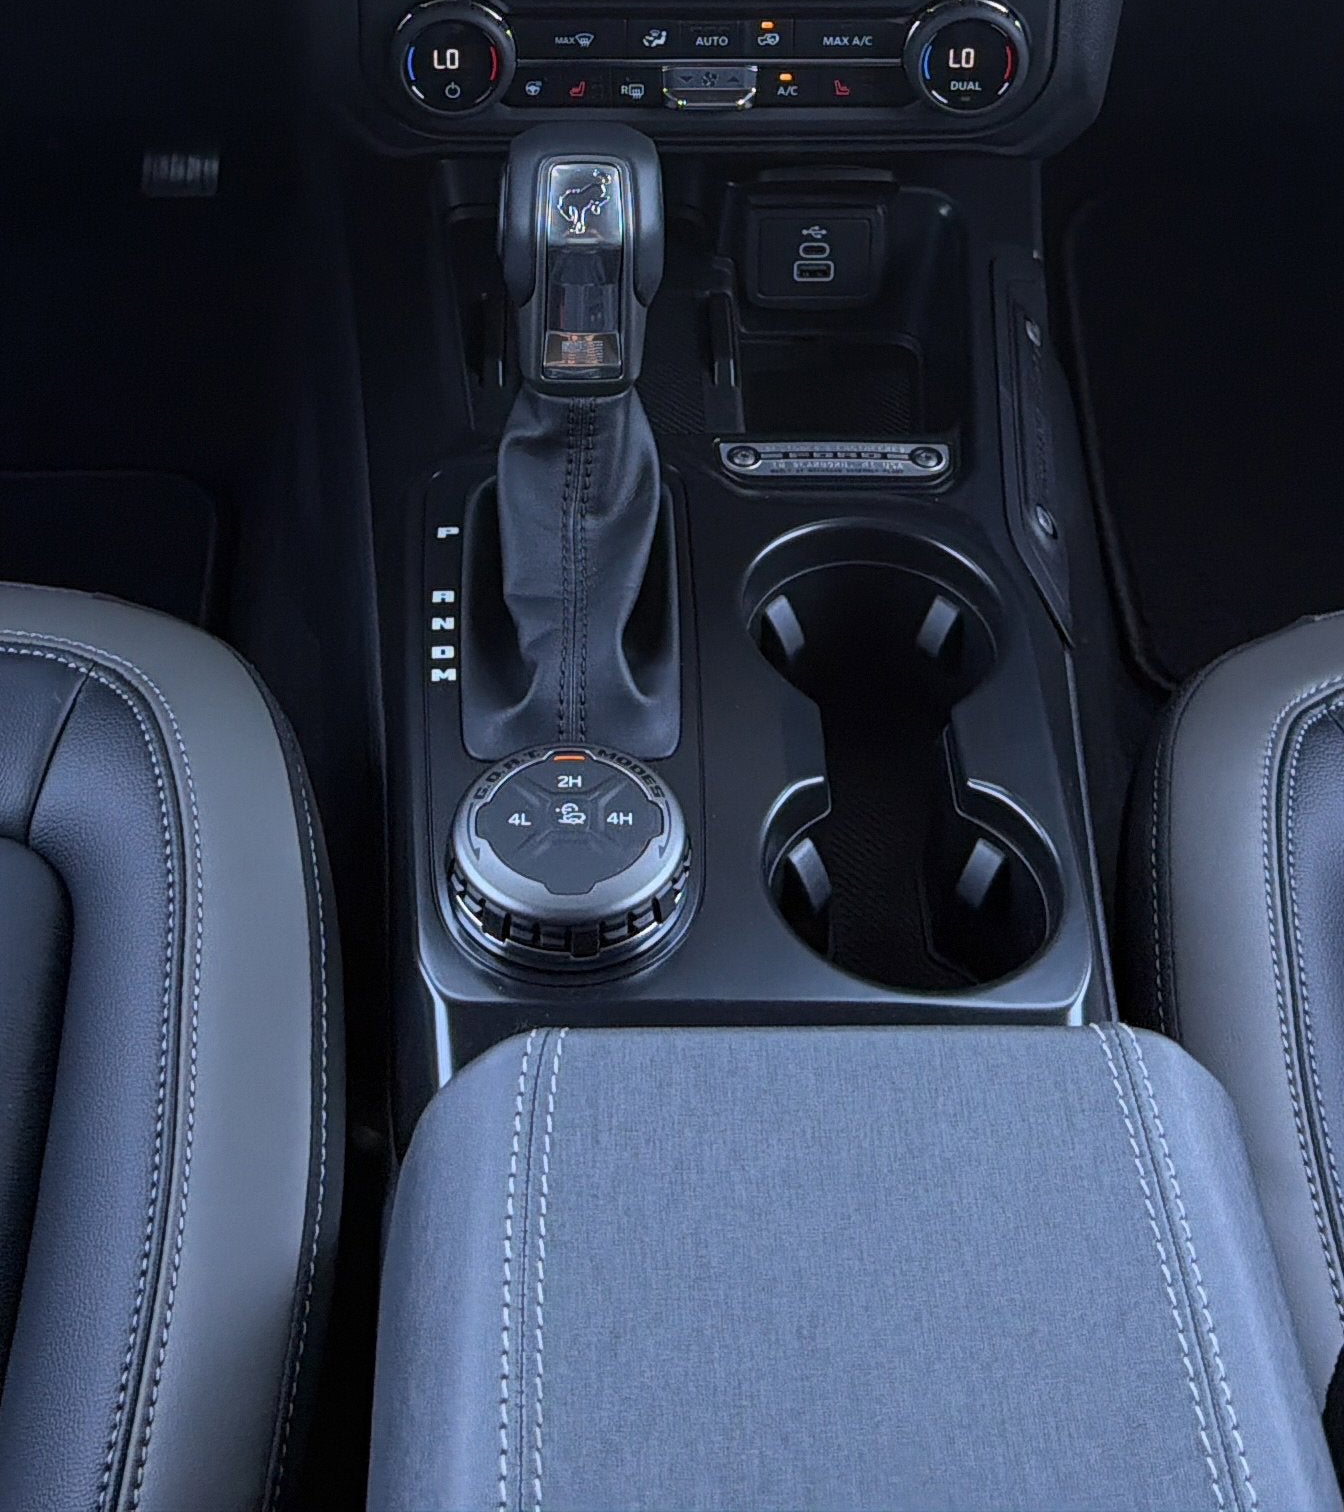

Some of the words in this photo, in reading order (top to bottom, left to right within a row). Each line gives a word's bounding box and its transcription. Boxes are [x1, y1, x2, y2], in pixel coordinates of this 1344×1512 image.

[555, 36, 575, 45] MAX
[695, 36, 729, 46] AUTO
[823, 36, 849, 46] MAX
[851, 36, 873, 46] A/C
[432, 48, 460, 70] LO
[948, 47, 975, 69] LO
[777, 86, 799, 96] A/C
[950, 81, 981, 91] DUAL
[437, 526, 460, 538] P
[431, 590, 455, 603] R
[431, 617, 455, 630] N
[431, 645, 455, 659] D
[431, 668, 457, 682] M
[598, 749, 666, 799] MODES
[557, 775, 582, 788] 2H
[508, 813, 532, 826] 4L
[607, 812, 633, 826] 4H
